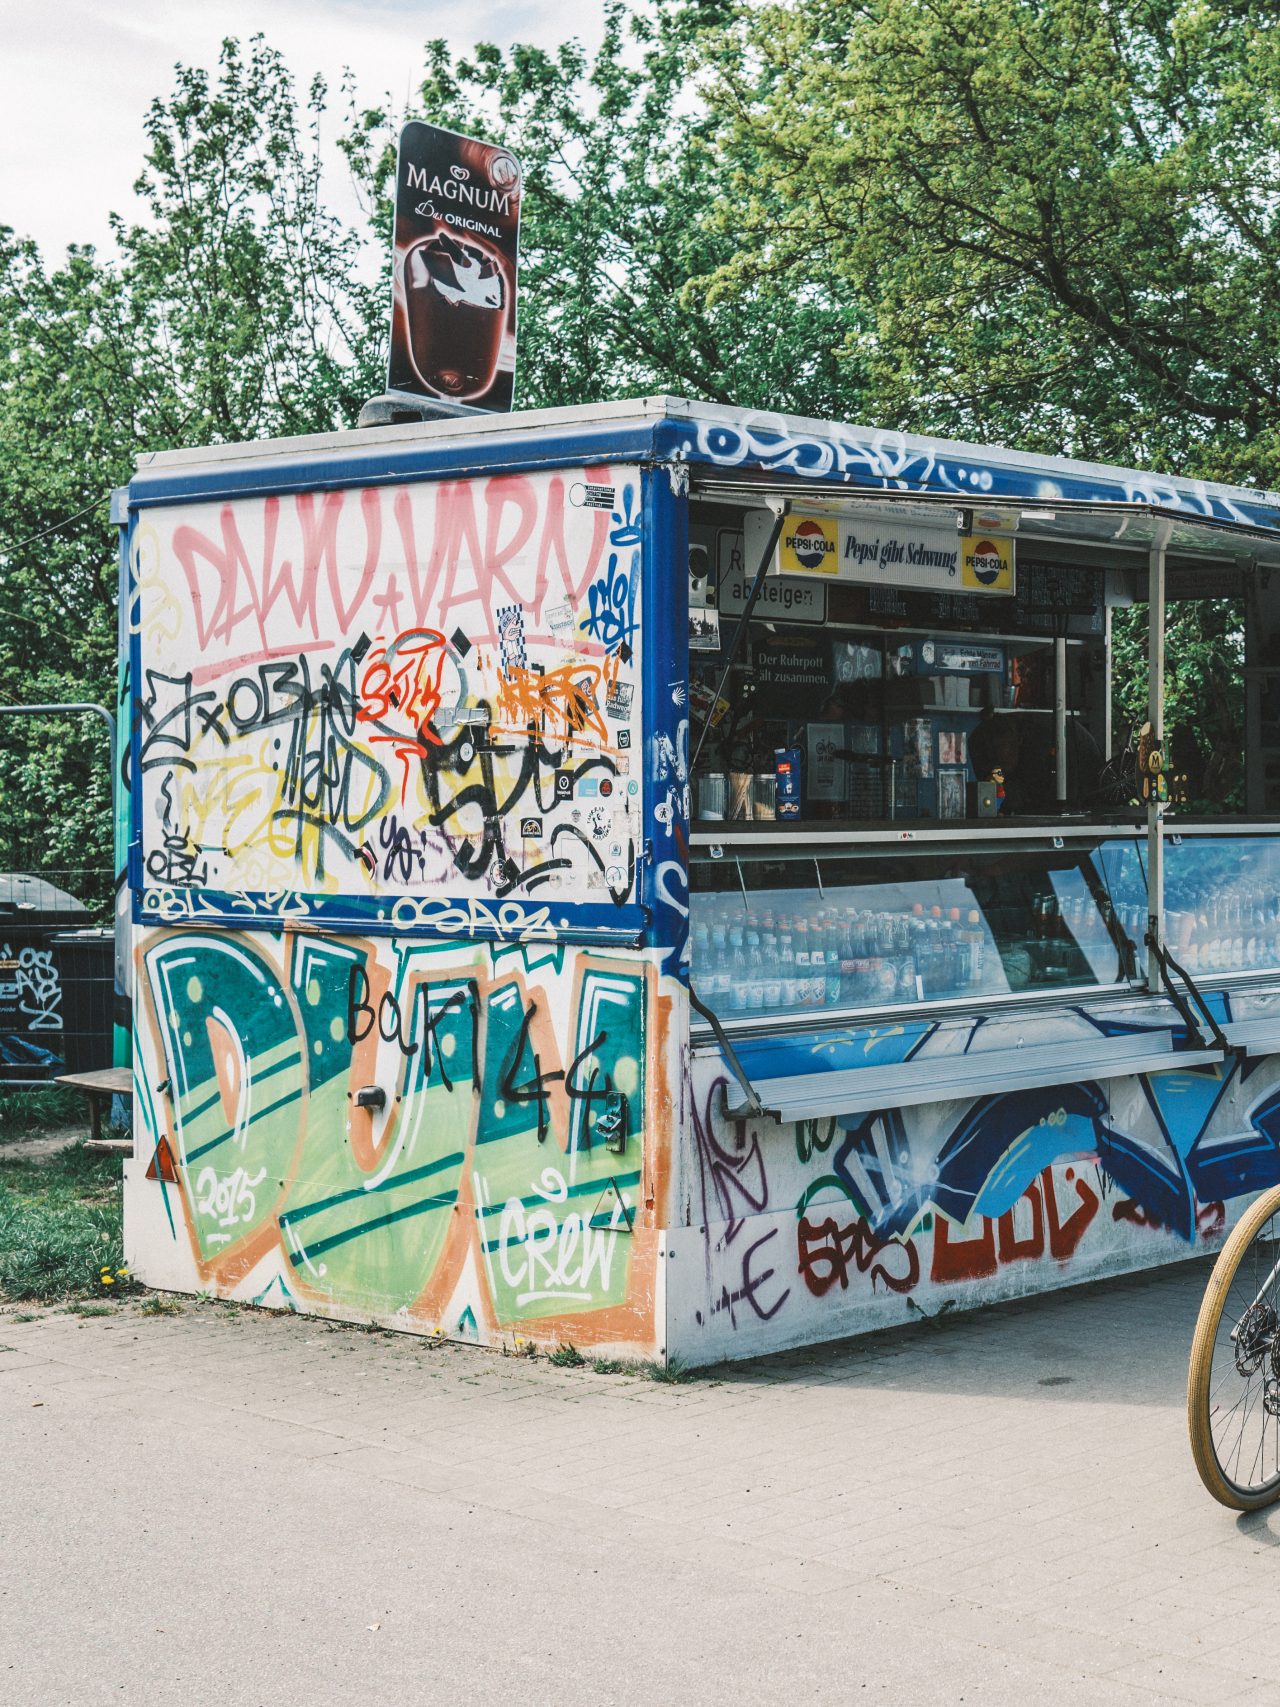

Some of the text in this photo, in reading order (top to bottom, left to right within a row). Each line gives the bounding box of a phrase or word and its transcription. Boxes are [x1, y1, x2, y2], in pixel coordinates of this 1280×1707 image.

[406, 162, 511, 216] MAGNUM
[415, 200, 502, 238] Das ORIGINAL
[844, 535, 879, 564] Pepsi
[880, 540, 904, 569] gibt
[906, 541, 957, 577] Schwung
[759, 653, 823, 670] Der Ruhrpott
[774, 672, 829, 685] zusammen.
